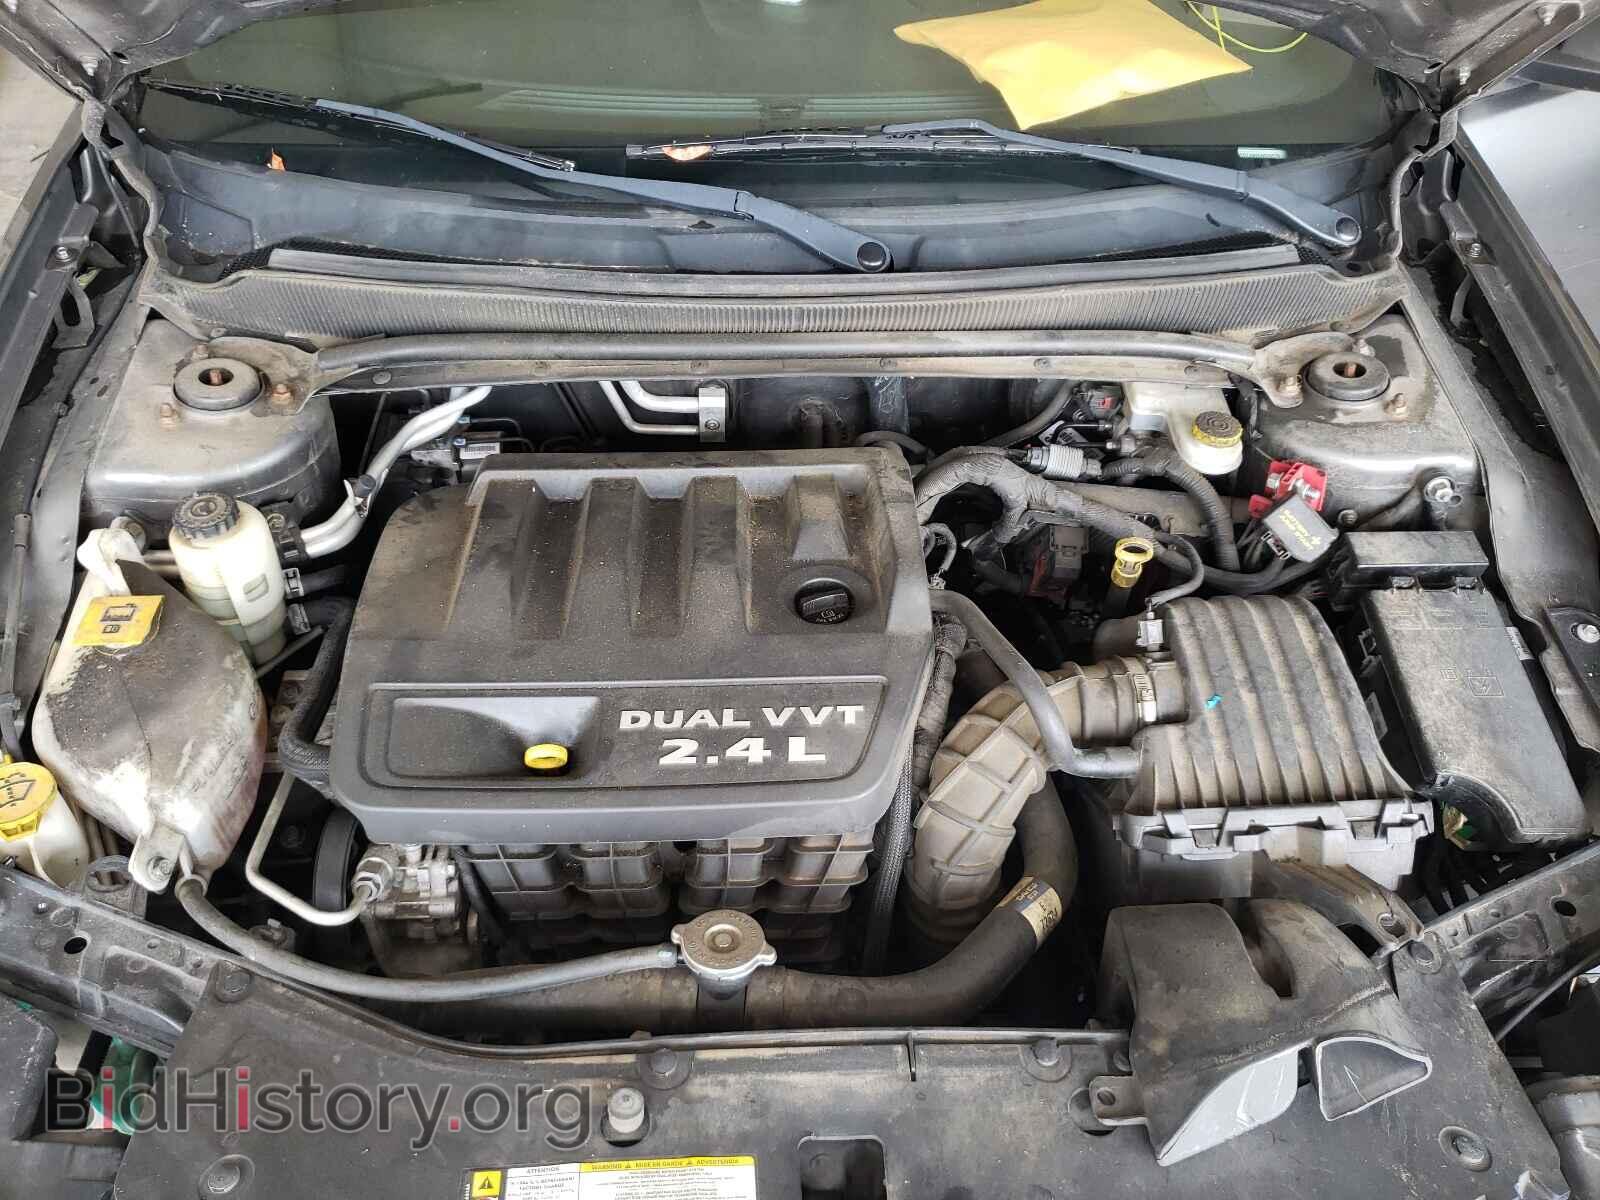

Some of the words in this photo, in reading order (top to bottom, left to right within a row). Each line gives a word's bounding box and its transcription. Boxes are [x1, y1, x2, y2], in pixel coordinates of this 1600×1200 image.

[619, 708, 751, 729] DUAL
[761, 705, 865, 727] VVT
[658, 737, 772, 766] 2.4
[787, 736, 826, 763] L
[526, 1166, 560, 1175] ATTENTION
